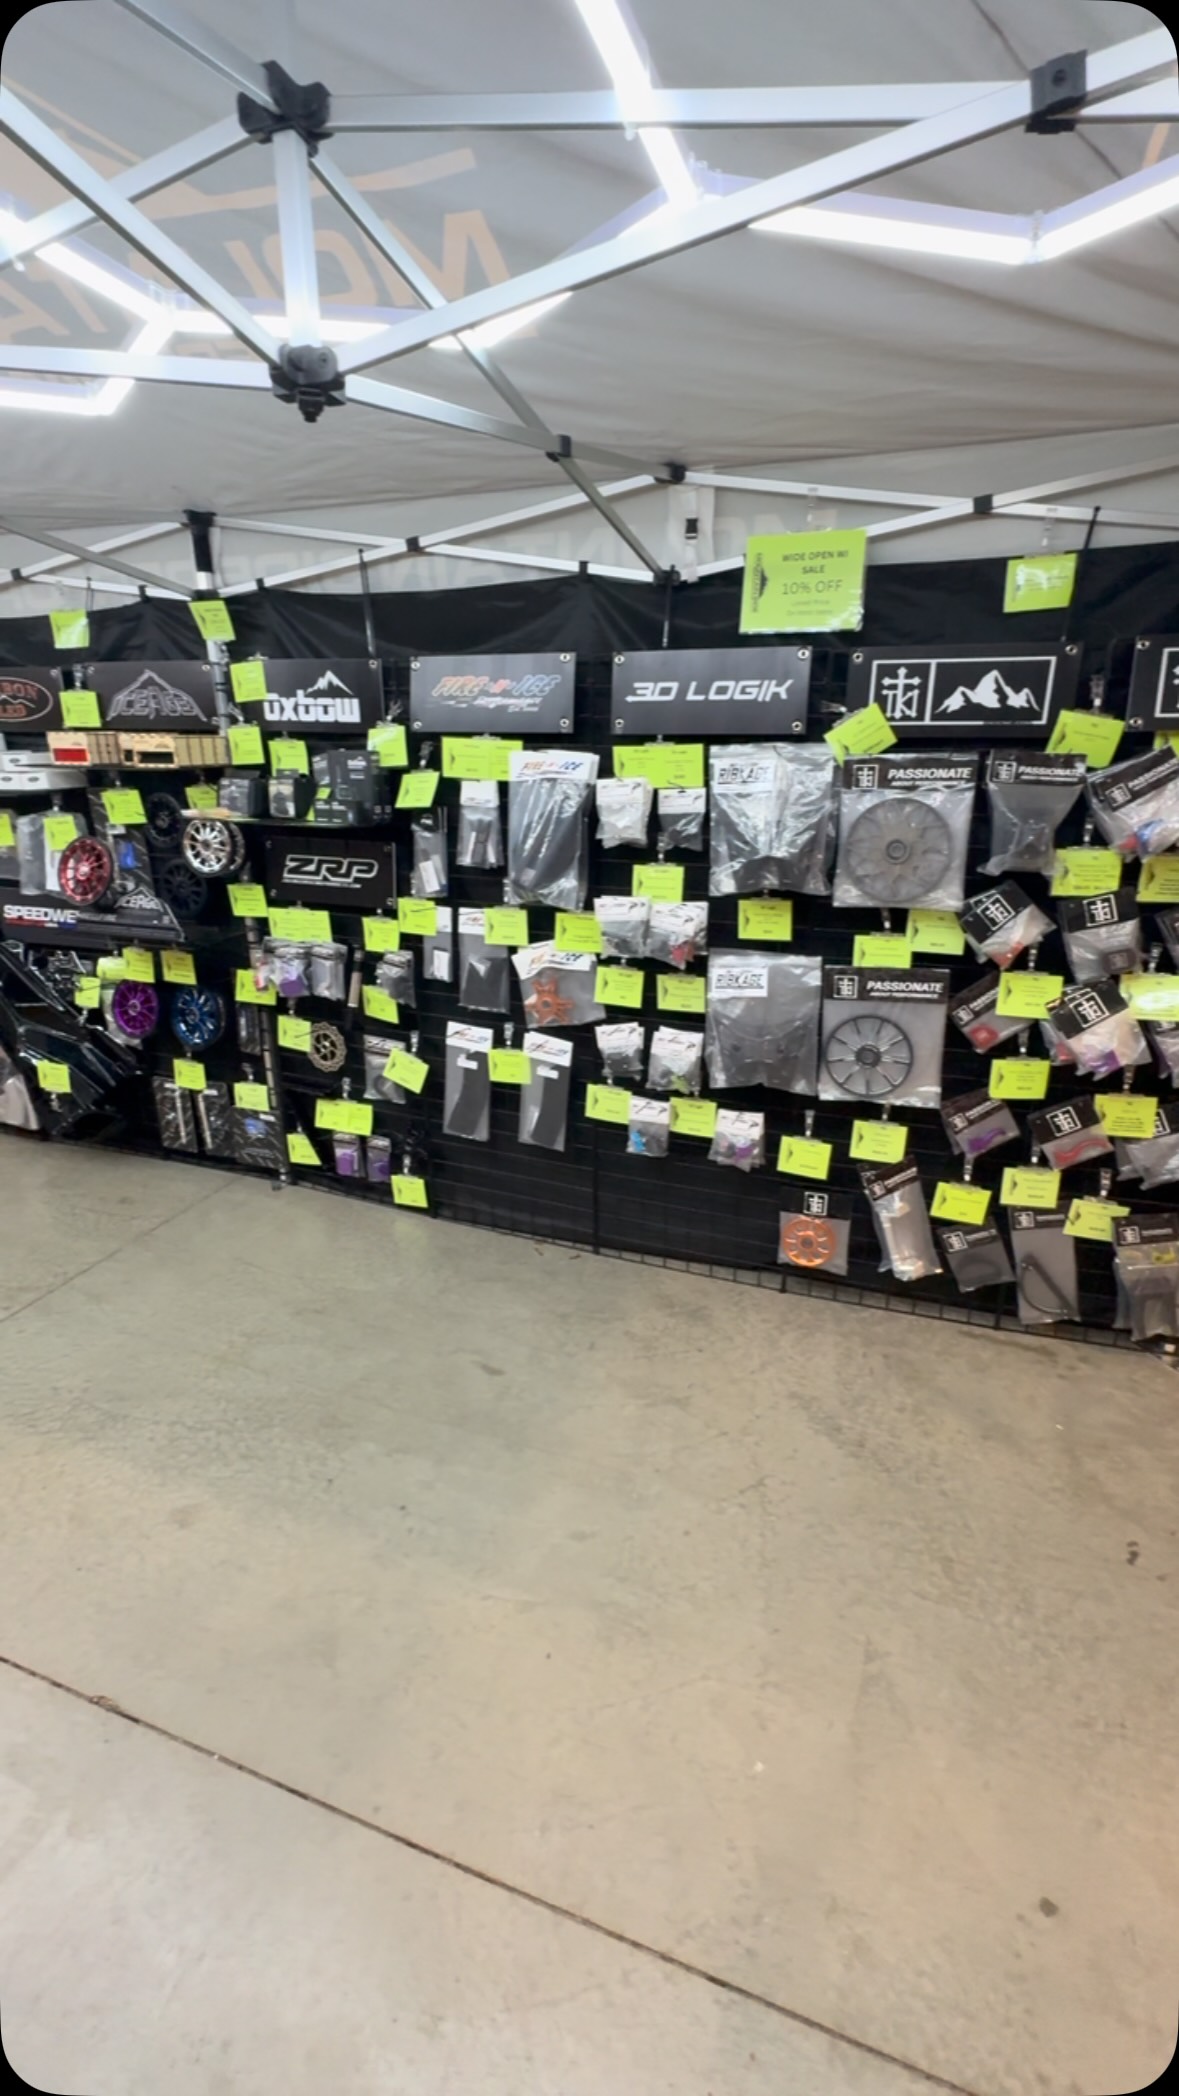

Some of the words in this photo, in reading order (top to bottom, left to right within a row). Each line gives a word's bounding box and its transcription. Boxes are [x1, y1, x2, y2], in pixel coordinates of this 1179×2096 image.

[782, 552, 806, 562] WIDE
[808, 550, 834, 560] OPEN
[802, 564, 825, 575] SALE
[782, 581, 811, 595] 10%
[815, 578, 843, 593] OFF
[625, 682, 679, 703] 3D
[685, 679, 794, 702] LOGIK
[887, 767, 973, 780] PASSIONATE
[282, 854, 379, 883] ZRP
[3, 904, 80, 923] SPEEDWE
[866, 980, 945, 994] PASSIONATE
